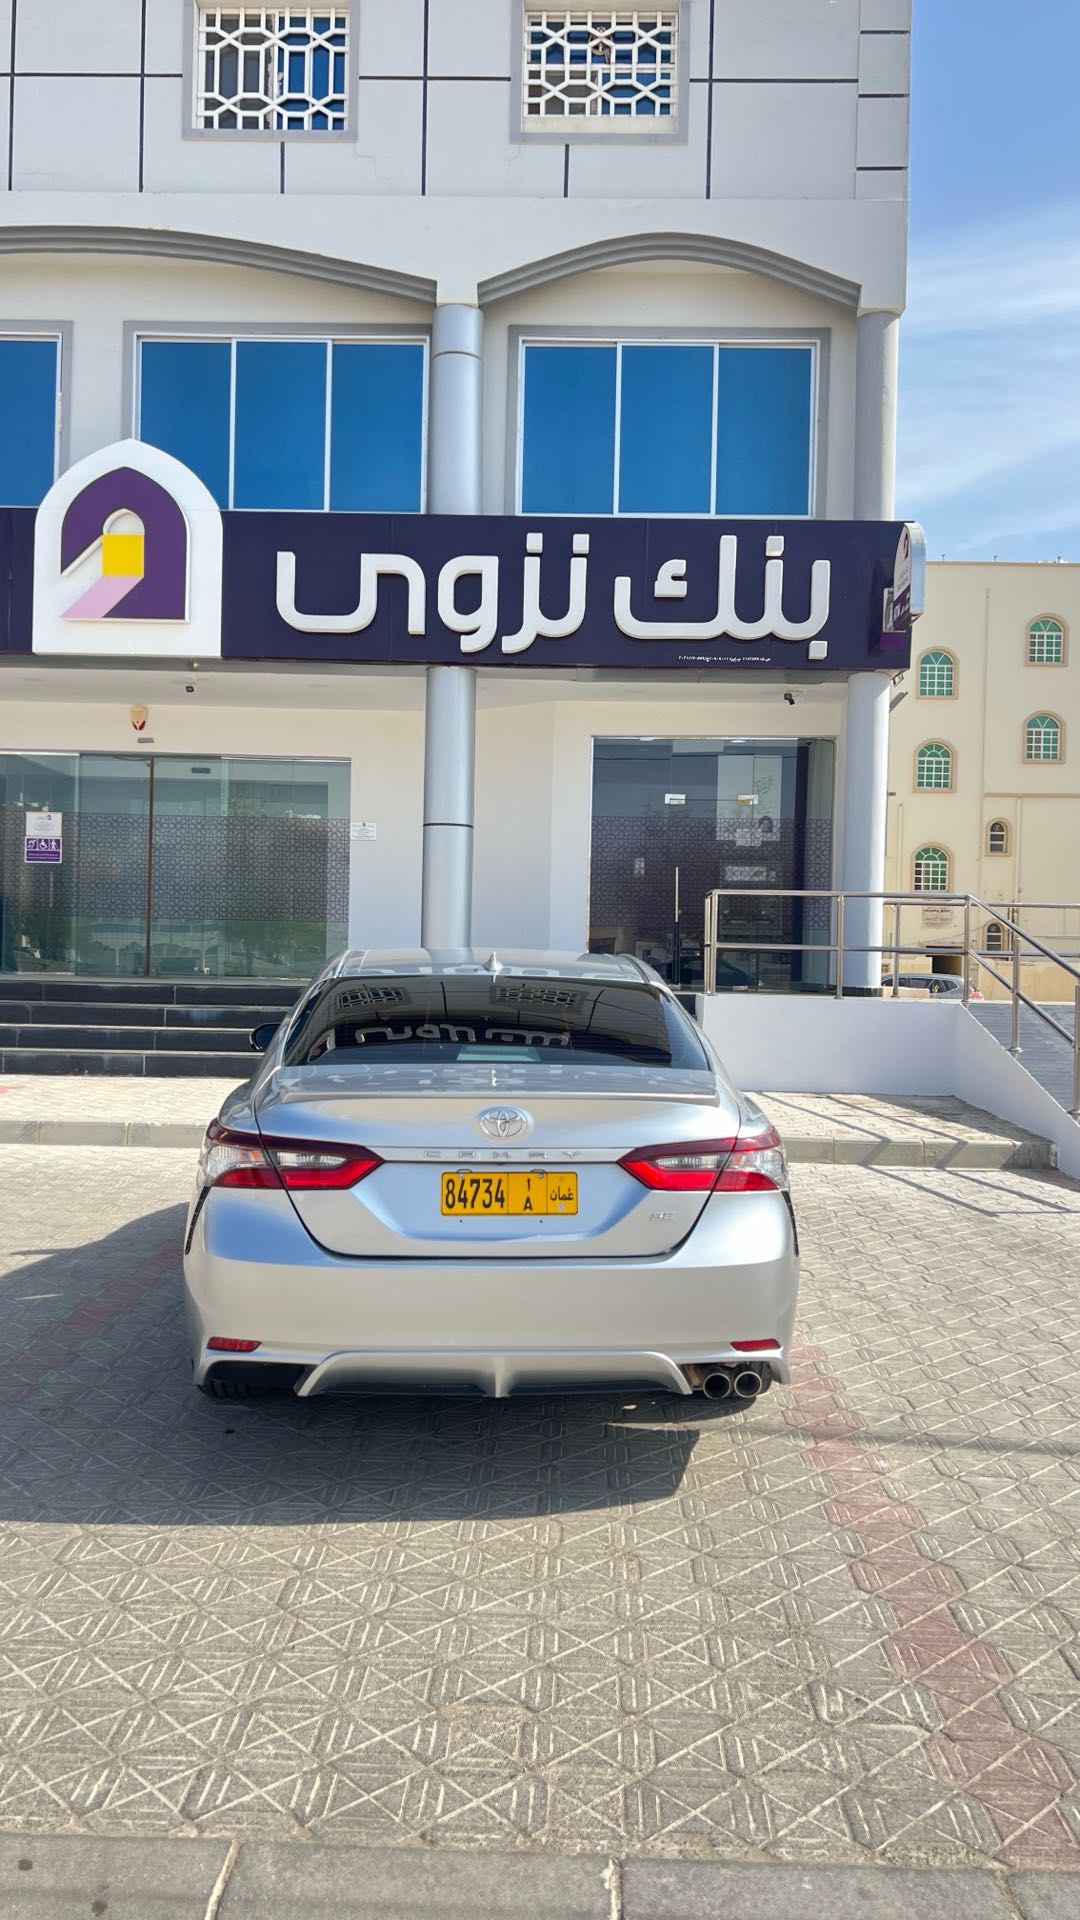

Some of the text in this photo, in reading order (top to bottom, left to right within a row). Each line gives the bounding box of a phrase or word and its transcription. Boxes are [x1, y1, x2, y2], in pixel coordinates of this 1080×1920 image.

[614, 534, 831, 661] بنك
[445, 1178, 505, 1209] 84734
[523, 1197, 533, 1211] A
